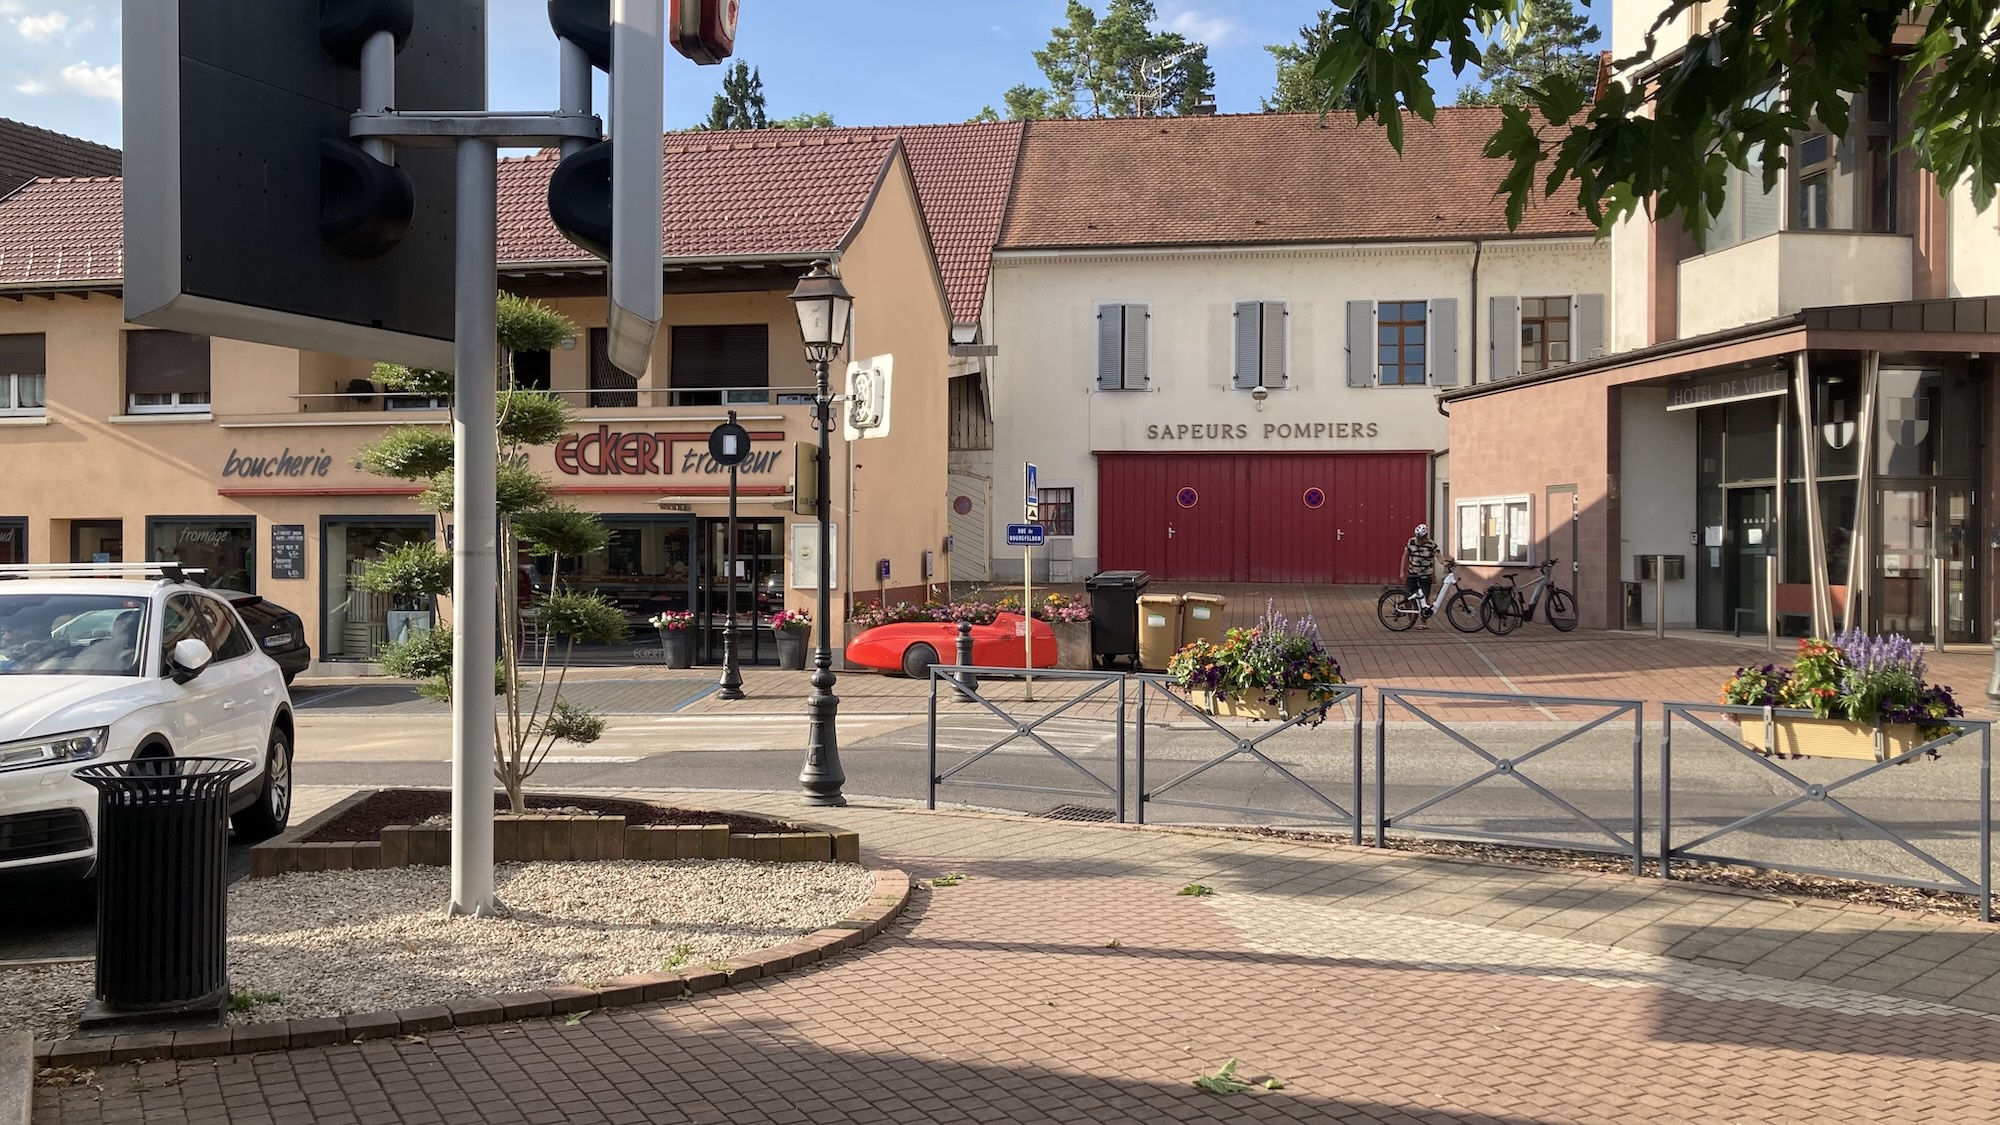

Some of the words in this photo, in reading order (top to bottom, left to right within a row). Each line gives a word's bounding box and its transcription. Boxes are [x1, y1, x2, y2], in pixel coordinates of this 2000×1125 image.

[1674, 385, 1713, 405] HOTEL
[1720, 381, 1738, 399] DE
[1743, 374, 1780, 393] VILLE
[1147, 424, 1247, 440] SAPEURS
[1263, 423, 1379, 439] POMPIERS
[222, 447, 332, 477] boucherie
[681, 447, 782, 475] traeur
[179, 526, 228, 546] fromage
